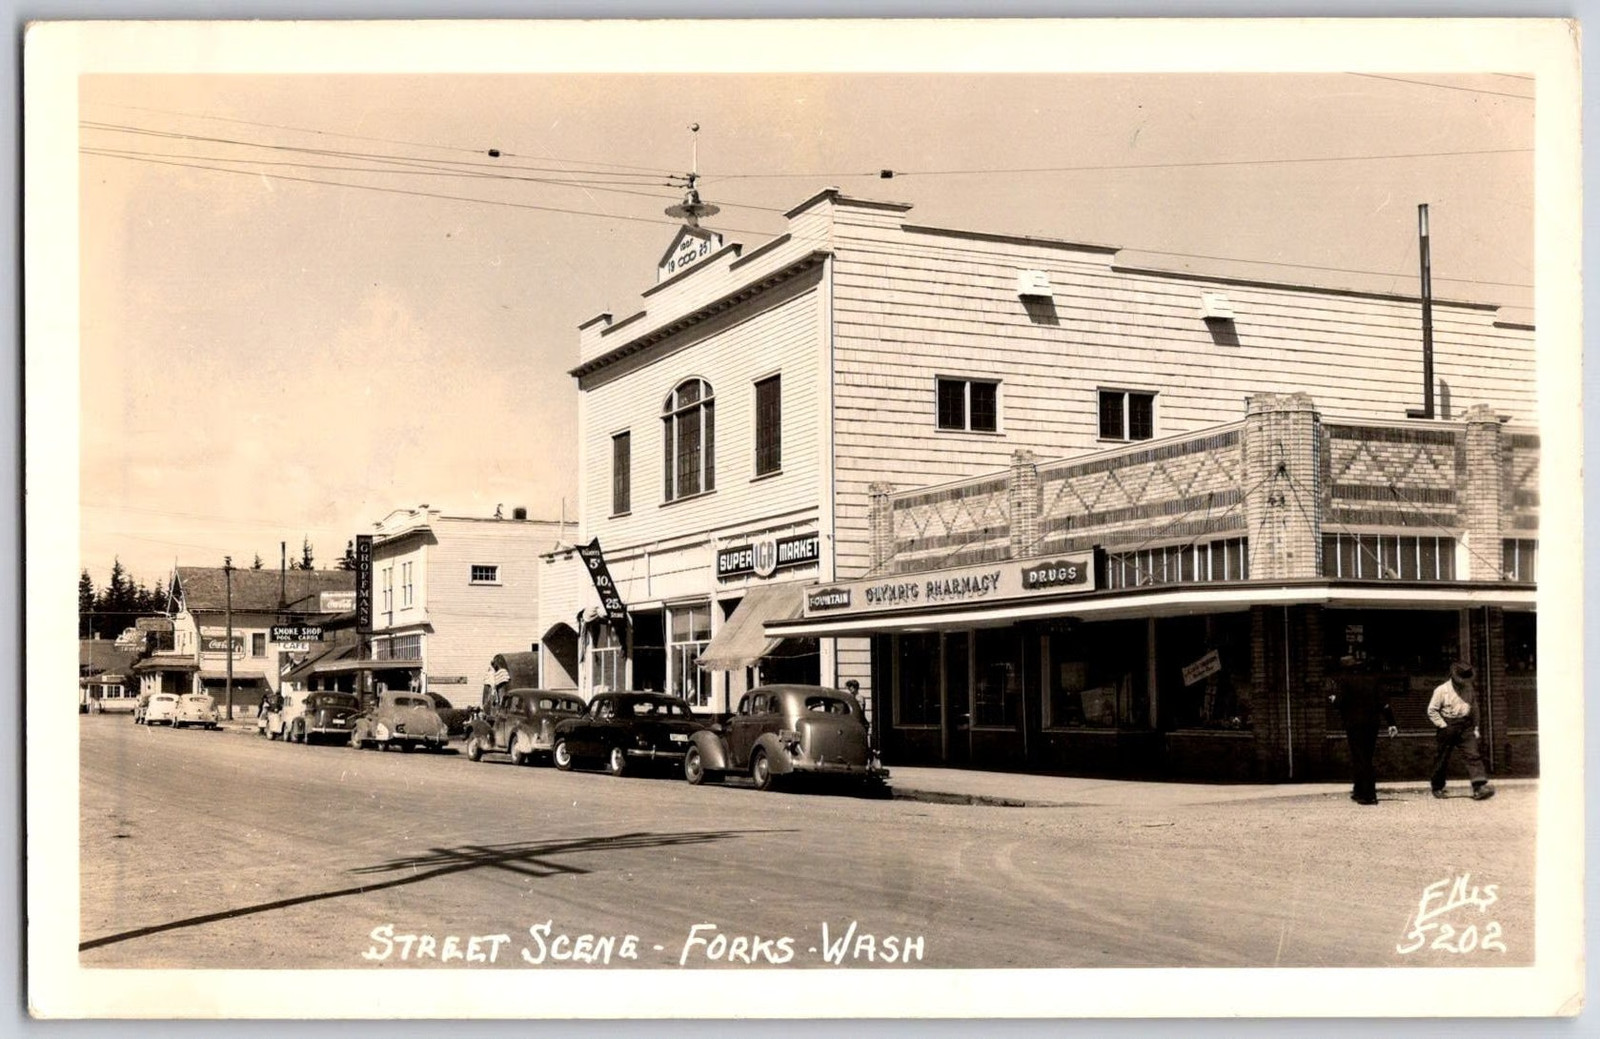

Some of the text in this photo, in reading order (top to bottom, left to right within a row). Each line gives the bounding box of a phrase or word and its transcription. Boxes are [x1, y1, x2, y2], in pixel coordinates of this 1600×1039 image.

[720, 538, 818, 571] SUPER IGA MARKET
[1029, 566, 1077, 583] DRUGS
[865, 570, 1001, 603] OLYMPIC PHARMACY
[808, 592, 849, 607] FOUNTAIN
[273, 627, 322, 635] SMOKE SHOP
